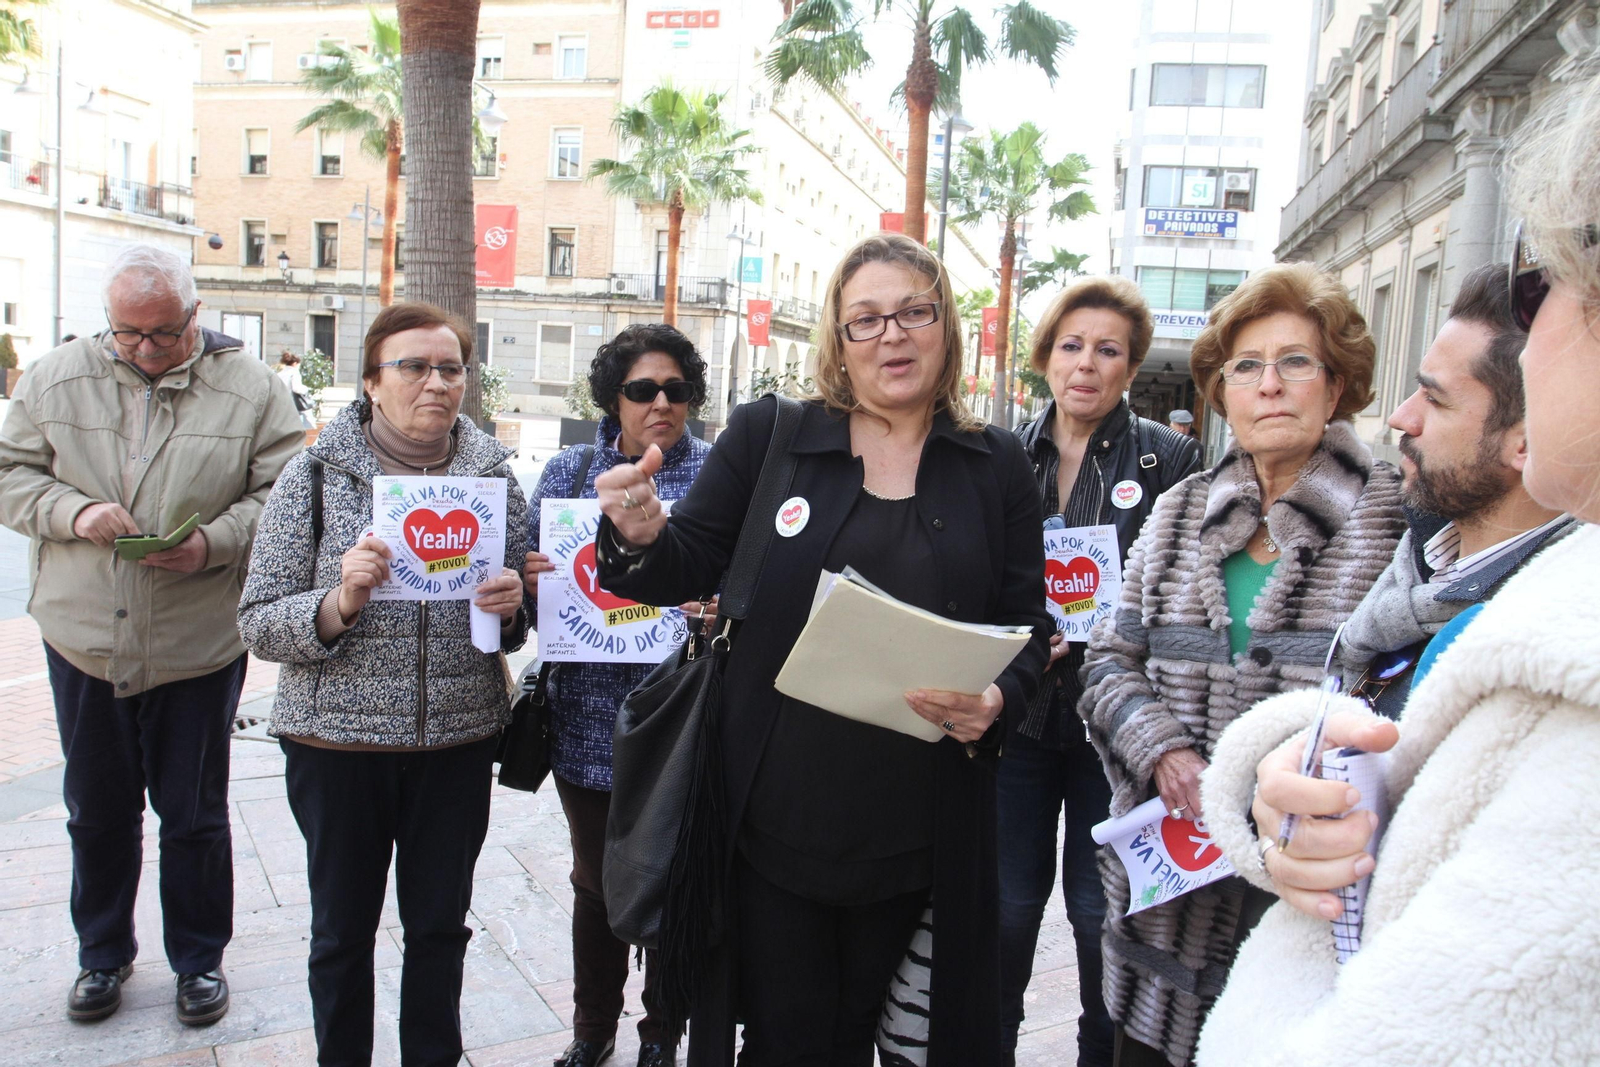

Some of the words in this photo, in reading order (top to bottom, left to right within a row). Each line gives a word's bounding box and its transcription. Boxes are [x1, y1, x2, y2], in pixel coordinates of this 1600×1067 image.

[646, 10, 720, 29] CCOO
[1148, 210, 1235, 223] DETECTIVES
[1164, 221, 1218, 233] PRIVADOS
[387, 485, 437, 521] HUELVA
[441, 484, 468, 504] POR
[470, 496, 494, 524] UNA
[410, 525, 472, 550] Yeah!!
[1061, 536, 1085, 551] POR
[1088, 544, 1109, 568] UNA
[428, 556, 467, 573] #YOVOY
[390, 558, 441, 594] SANIDAD
[1045, 572, 1095, 594] Yeah!!
[608, 604, 657, 626] #YOVOY
[1065, 599, 1094, 615] #YOVOY
[559, 605, 627, 655] SANIDAD
[1129, 834, 1190, 896] HUELVA
